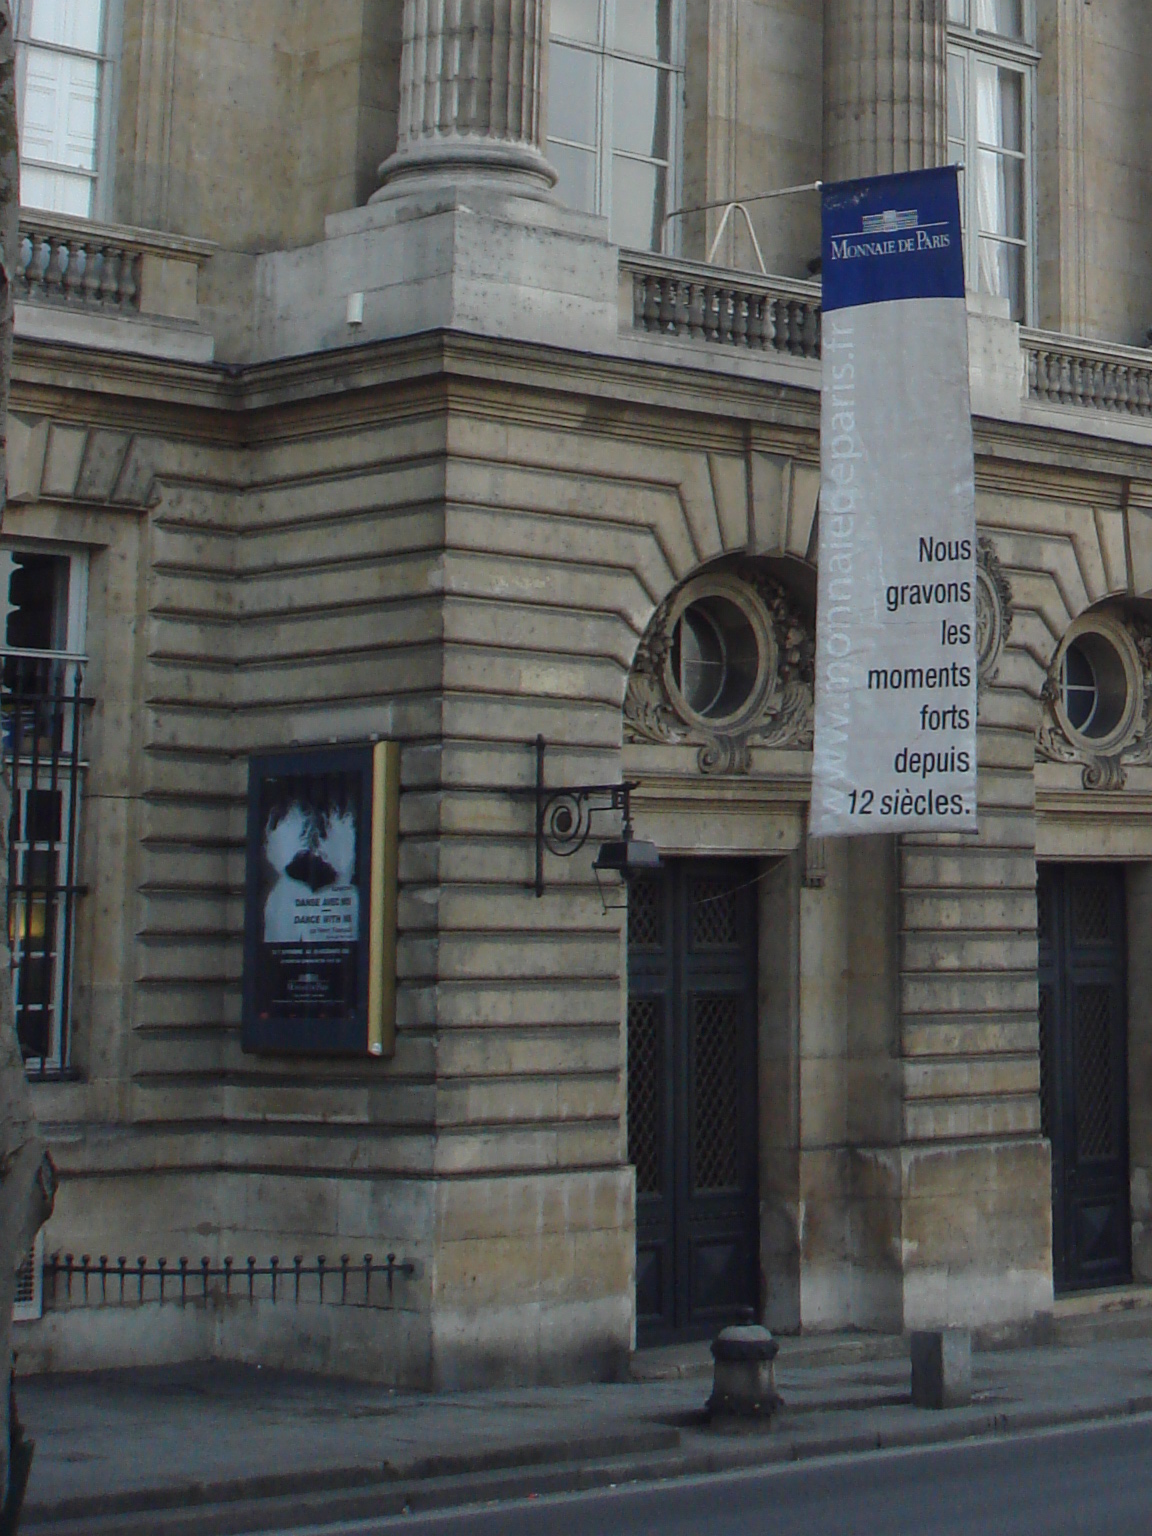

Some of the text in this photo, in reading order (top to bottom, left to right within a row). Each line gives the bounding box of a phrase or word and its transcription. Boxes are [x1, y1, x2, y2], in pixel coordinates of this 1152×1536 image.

[919, 536, 971, 563] Nous
[820, 323, 862, 821] www.monnaiedeparis.fr
[886, 581, 971, 611] gravons
[941, 620, 971, 645] les
[867, 662, 971, 689] moments
[920, 704, 970, 730] forts
[894, 746, 970, 779] depuis
[848, 787, 971, 815] 12 siècles.
